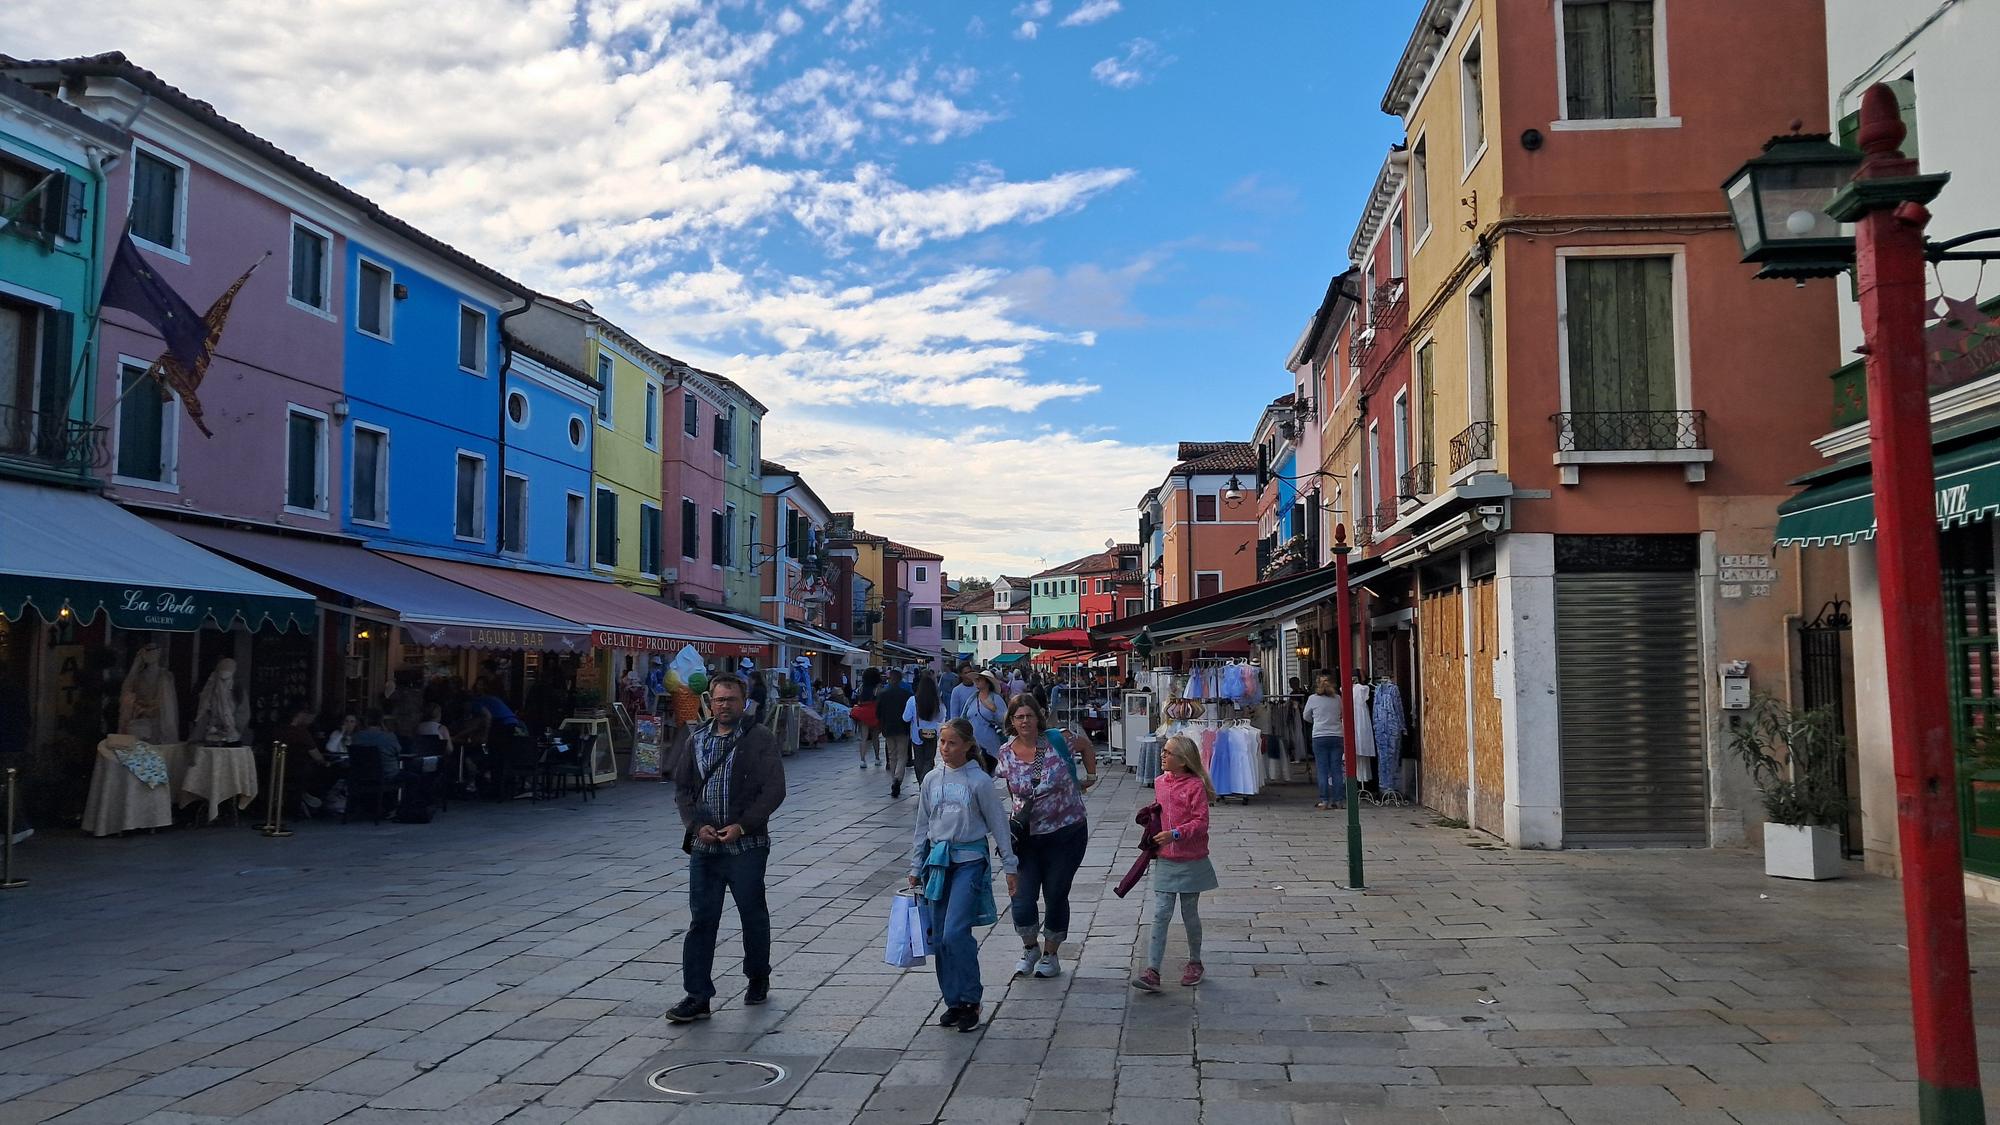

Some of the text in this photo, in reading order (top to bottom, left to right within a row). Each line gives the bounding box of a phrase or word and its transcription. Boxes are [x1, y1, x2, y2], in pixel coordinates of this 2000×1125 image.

[120, 589, 197, 614] La Perla
[144, 615, 175, 624] GALLERY
[469, 630, 516, 645] LAGUNA
[523, 633, 544, 646] BAR
[599, 632, 634, 648] GELATI
[637, 636, 643, 649] E
